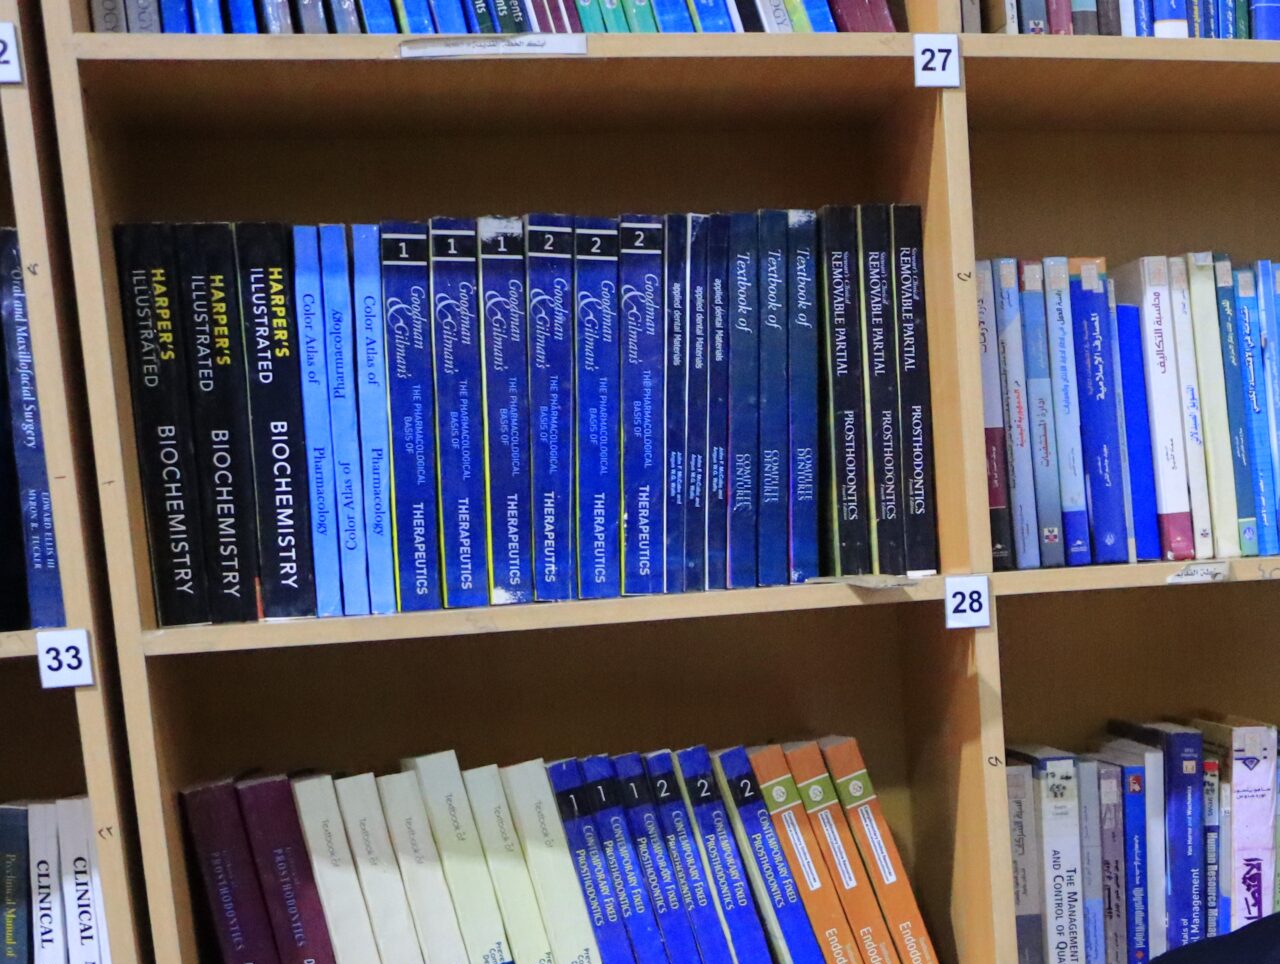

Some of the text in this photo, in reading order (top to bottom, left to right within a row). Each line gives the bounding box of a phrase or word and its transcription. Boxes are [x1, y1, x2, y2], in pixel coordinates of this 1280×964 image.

[920, 48, 953, 72] 27
[398, 242, 409, 258] 1
[447, 238, 458, 254] 1
[497, 236, 508, 252] 1
[544, 235, 555, 250] 2
[591, 237, 601, 253] 2
[634, 231, 645, 247] 2
[14, 300, 27, 323] and
[151, 269, 175, 360] HARPER'S
[268, 267, 290, 357] HARPER'S
[410, 286, 426, 350] Goodman
[458, 281, 477, 345] Goodman
[507, 279, 524, 342] Goodman
[553, 277, 568, 341] Goodman
[599, 280, 616, 343] Goodman
[643, 273, 659, 337] Goodman
[737, 252, 752, 316] Textbook
[769, 249, 782, 311] Textbook
[798, 248, 812, 311] Textbook
[832, 251, 848, 377] REMOVABLE PARTIAL
[869, 251, 885, 377] REMOVABLE PARTIAL
[900, 247, 916, 371] REMOVABLE PARTIAL
[132, 270, 159, 387] ILLUSTRATED
[191, 276, 214, 392] ILLUSTRATED
[209, 275, 231, 366] HARPER'S
[250, 268, 273, 384] ILLUSTRATED
[302, 294, 318, 370] Color Atlas
[332, 308, 347, 400] Pharmacology
[363, 295, 378, 370] Color Atlas
[1091, 312, 1102, 352] المصارف
[1152, 292, 1167, 374] محاسبة التكاليف
[16, 326, 35, 401] Maxillofacial
[22, 404, 36, 449] Surgery
[844, 410, 858, 520] PROSTHODONTICS
[882, 410, 896, 520] PROSTHODONTICS
[911, 405, 925, 515] PROSTHODONTICS
[157, 425, 194, 595] BIOCHEMISTRY
[211, 430, 240, 598] BIOCHEMISTRY
[270, 421, 298, 589] BIOCHEMISTRY
[313, 447, 329, 537] Pharmacology
[342, 477, 358, 551] Color Atlas
[371, 448, 387, 537] Pharmacology
[638, 484, 650, 576] THERAPEUTICS
[412, 502, 428, 596] THERAPEUTICS
[458, 497, 472, 590] THERAPEUTICS
[507, 493, 521, 586] THERAPEUTICS
[543, 490, 556, 583] THERAPEUTICS
[594, 492, 606, 584] THERAPEUTICS
[952, 590, 983, 614] 28
[45, 645, 83, 671] 33
[569, 795, 578, 811] 1
[597, 787, 606, 802] 1
[629, 783, 639, 799] 1
[657, 780, 671, 798] 2
[697, 780, 711, 797] 2
[740, 780, 754, 797] 2
[576, 849, 604, 928] PROSTHODONTICS
[583, 825, 618, 923] CONTEMPORARY FIXED
[603, 840, 632, 918] PROSTHODONTICS
[610, 815, 646, 914] CONTEMPORARY FIXED
[637, 837, 668, 915] PROSTHODONTICS
[643, 812, 680, 911] CONTEMPORARY FIXED
[666, 834, 695, 912] PROSTHODONTICS
[671, 810, 708, 908] CONTEMPORARY FIXED
[704, 834, 735, 912] PROSTHODONTICS
[712, 810, 748, 908] CONTEMPORARY FIXED
[751, 832, 784, 910] PROSTHODONTICS
[756, 808, 797, 905] CONTEMPORARY FIXED
[1052, 850, 1061, 870] AND
[1207, 832, 1218, 907] Human Resource
[5, 908, 16, 945] Manual
[37, 859, 53, 949] CLINICAL
[72, 856, 94, 946] CLINICAL
[210, 850, 245, 951] PROSTHODONTICS
[273, 848, 305, 947] PROSTHODONTICS
[1053, 875, 1064, 920] CONTROL
[1055, 925, 1064, 936] OF
[1066, 867, 1079, 963] THE MANAGEMENT
[1191, 868, 1202, 935] Management
